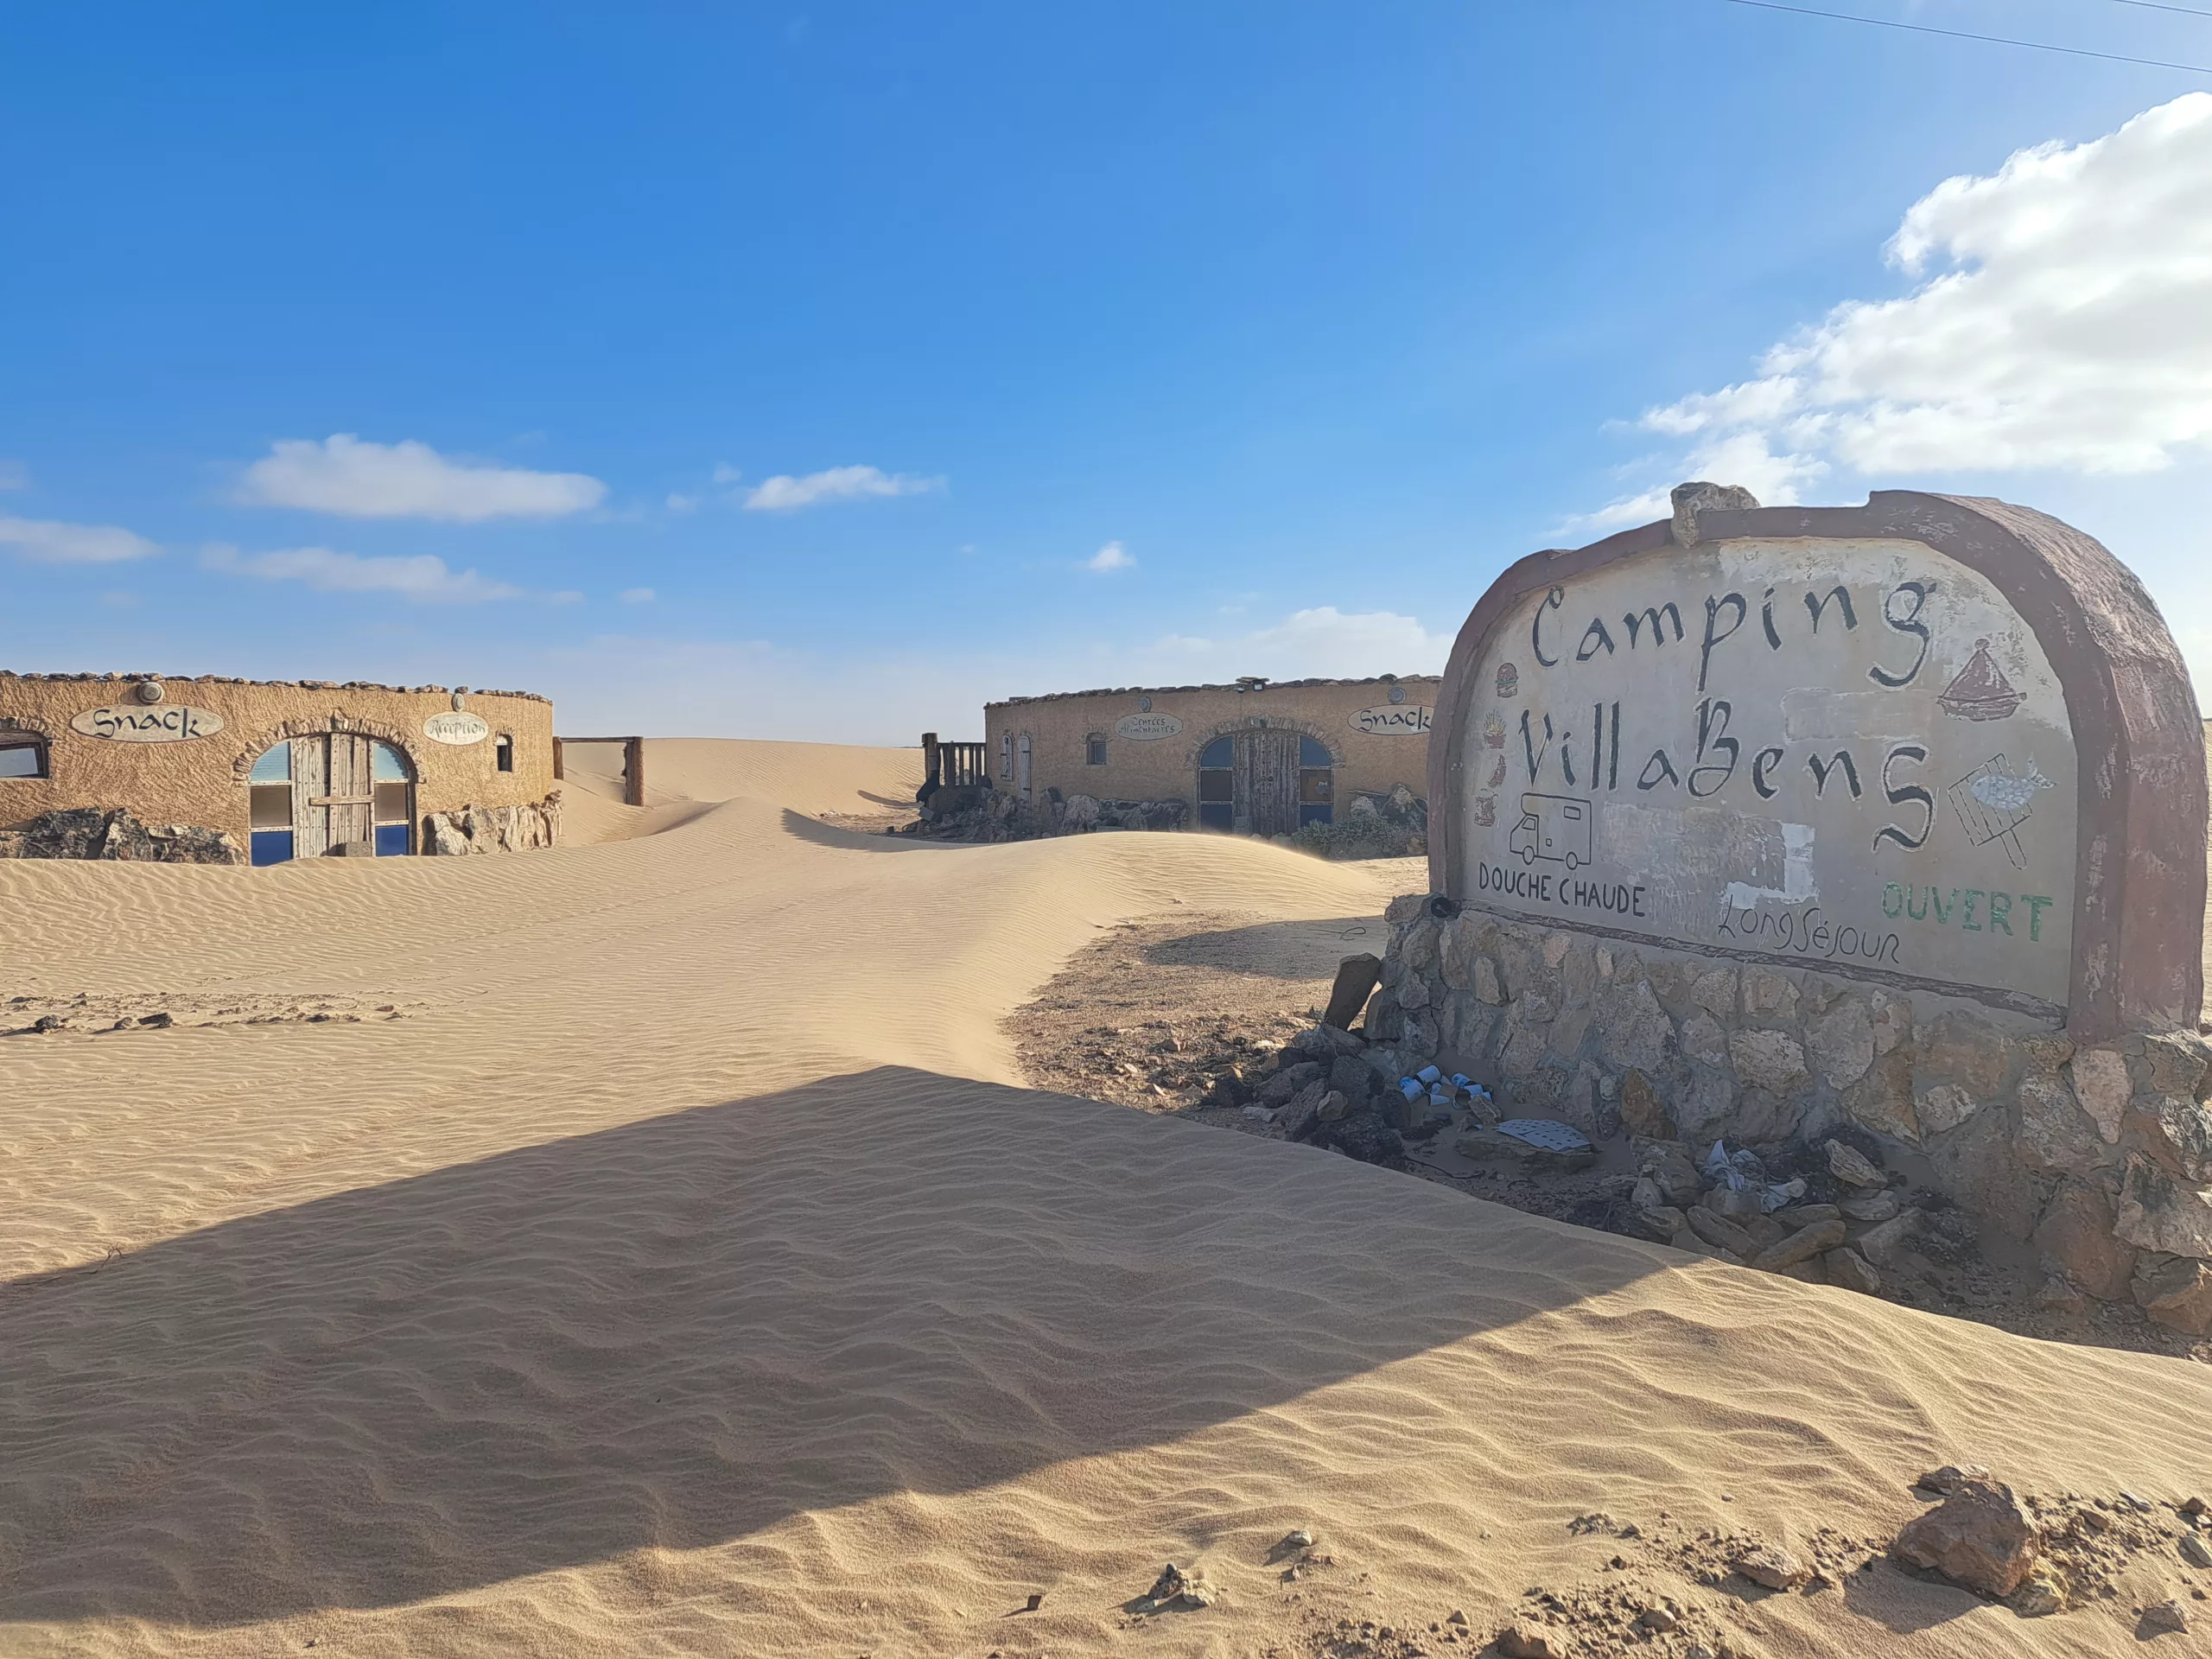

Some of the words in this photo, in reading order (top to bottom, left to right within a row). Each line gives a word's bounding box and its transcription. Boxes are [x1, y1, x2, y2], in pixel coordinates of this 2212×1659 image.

[1533, 582, 1937, 691] Camping
[93, 707, 201, 739] Snack
[1358, 706, 1431, 732] Snack
[1478, 861, 1552, 901] DOUCHE
[1559, 878, 1646, 918] CHAUDE
[1882, 880, 2054, 943] OUVERT
